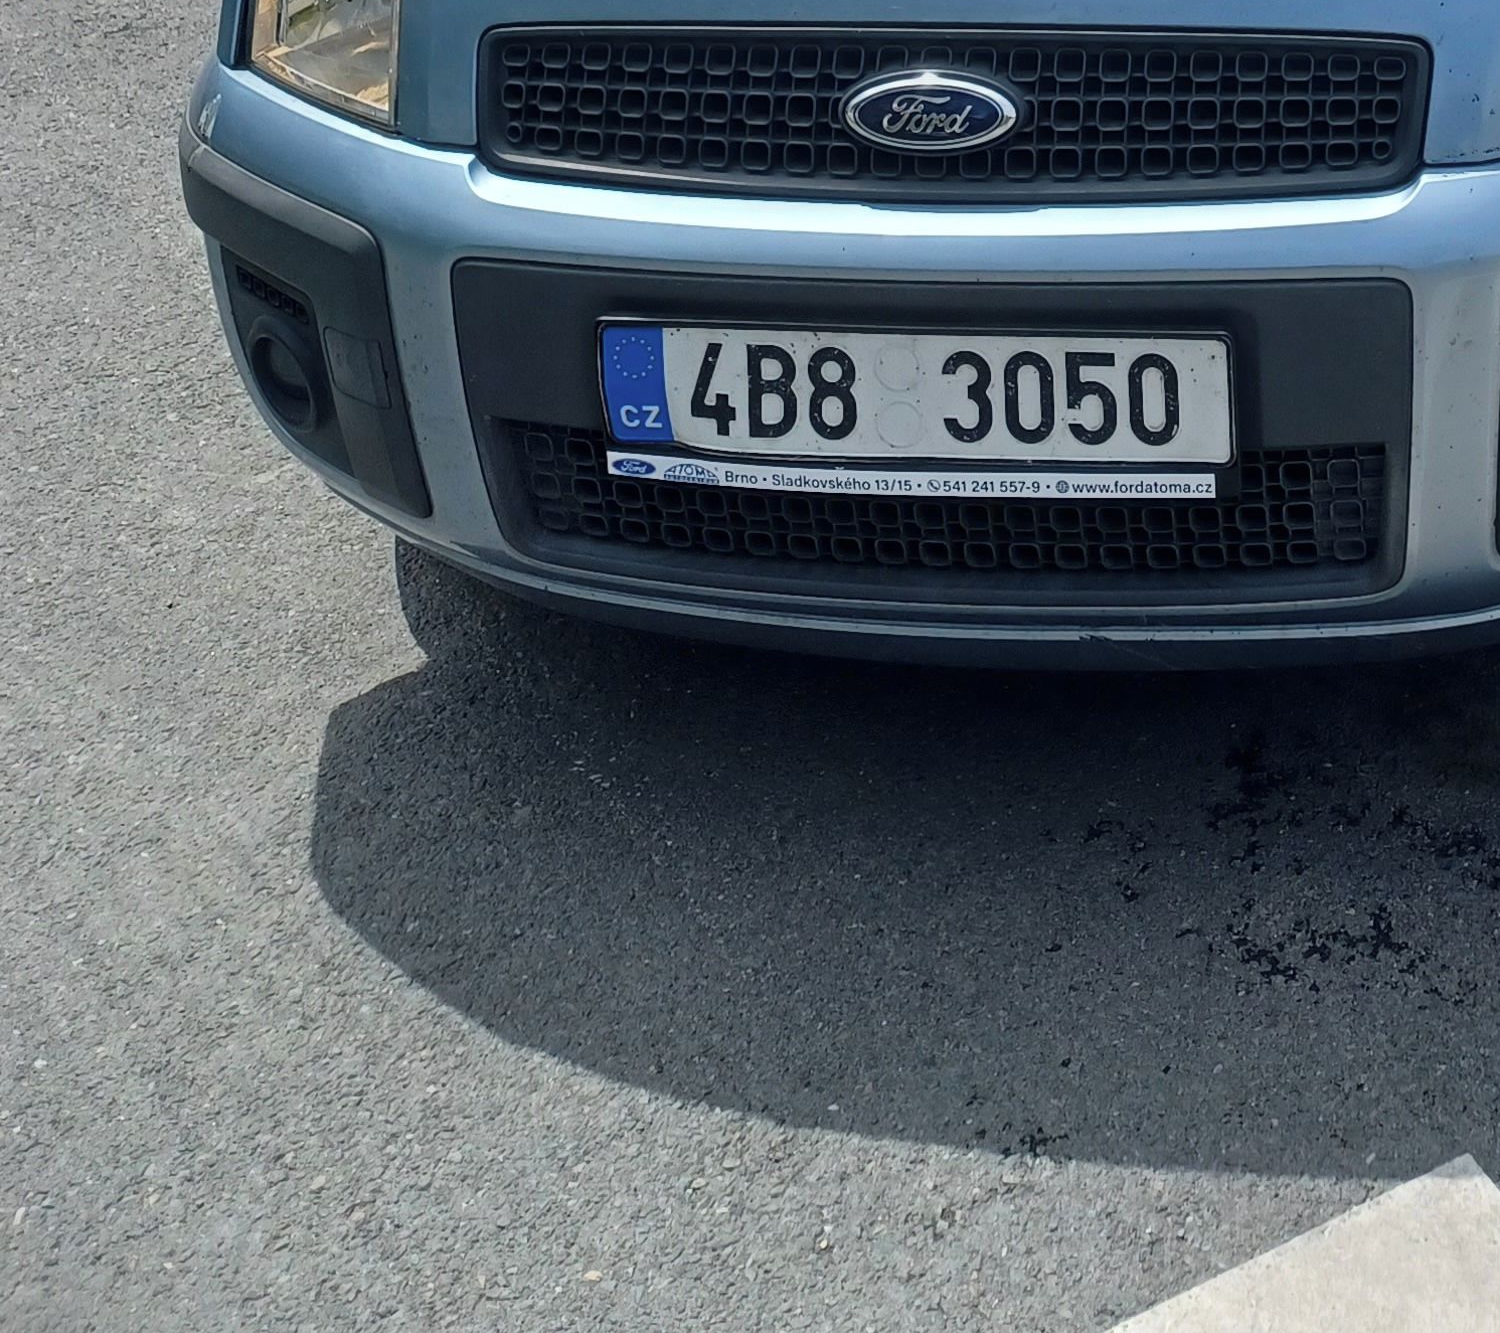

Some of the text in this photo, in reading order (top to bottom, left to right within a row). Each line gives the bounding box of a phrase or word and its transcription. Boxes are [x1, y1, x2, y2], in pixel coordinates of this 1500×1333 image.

[882, 93, 973, 135] Ford
[620, 341, 1180, 447] CZ 4B8 3050
[725, 471, 758, 485] Brno
[772, 474, 871, 491] Sladkovského
[875, 479, 913, 493] 13/15
[943, 481, 966, 493] 541
[971, 481, 995, 493] 241
[999, 481, 1040, 494] 557-9
[1072, 480, 1214, 495] www.fordatoma.cz
